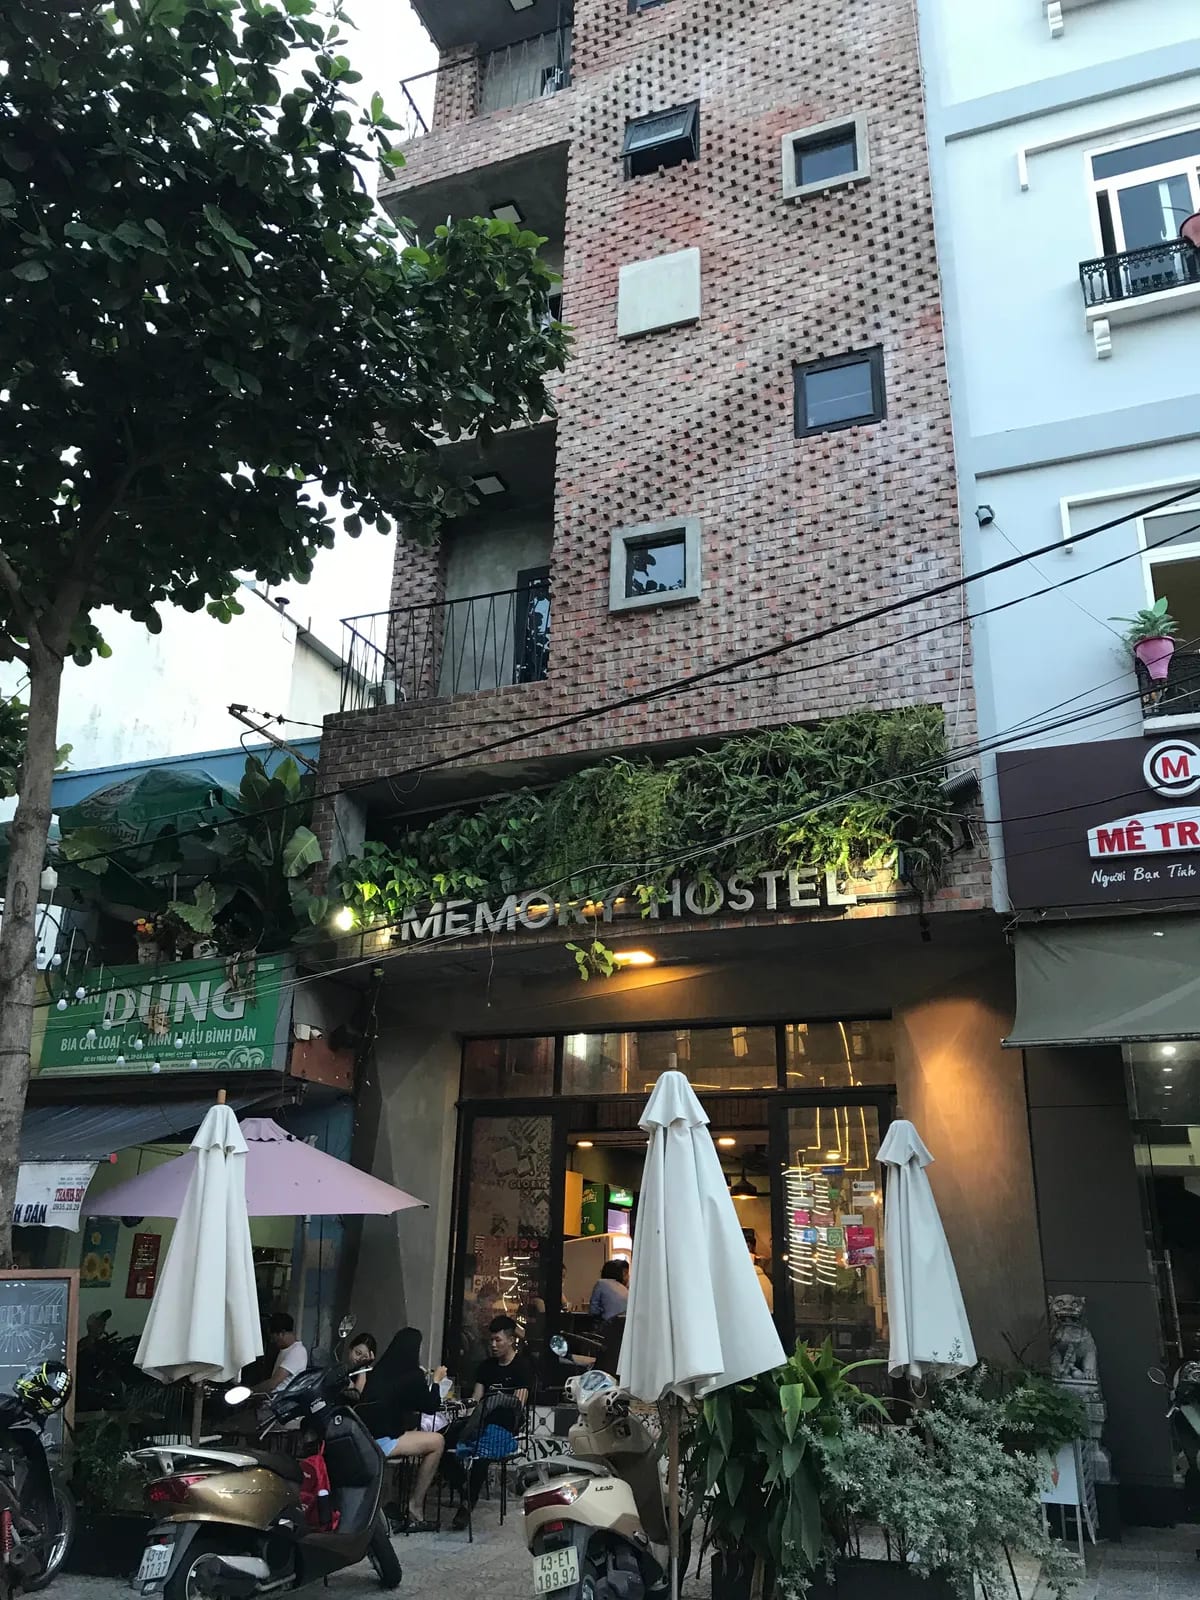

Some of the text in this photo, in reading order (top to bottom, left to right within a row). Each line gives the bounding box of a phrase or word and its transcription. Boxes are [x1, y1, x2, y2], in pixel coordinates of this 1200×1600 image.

[1096, 820, 1147, 854] MÊ
[1133, 867, 1160, 882] Bạn
[649, 867, 858, 919] HOSTEL
[61, 1038, 77, 1051] BIA
[98, 1035, 120, 1052] LOẠI
[205, 1027, 232, 1044] BÌNH
[234, 1025, 257, 1042] DÂN
[538, 1566, 576, 1591] 189.92
